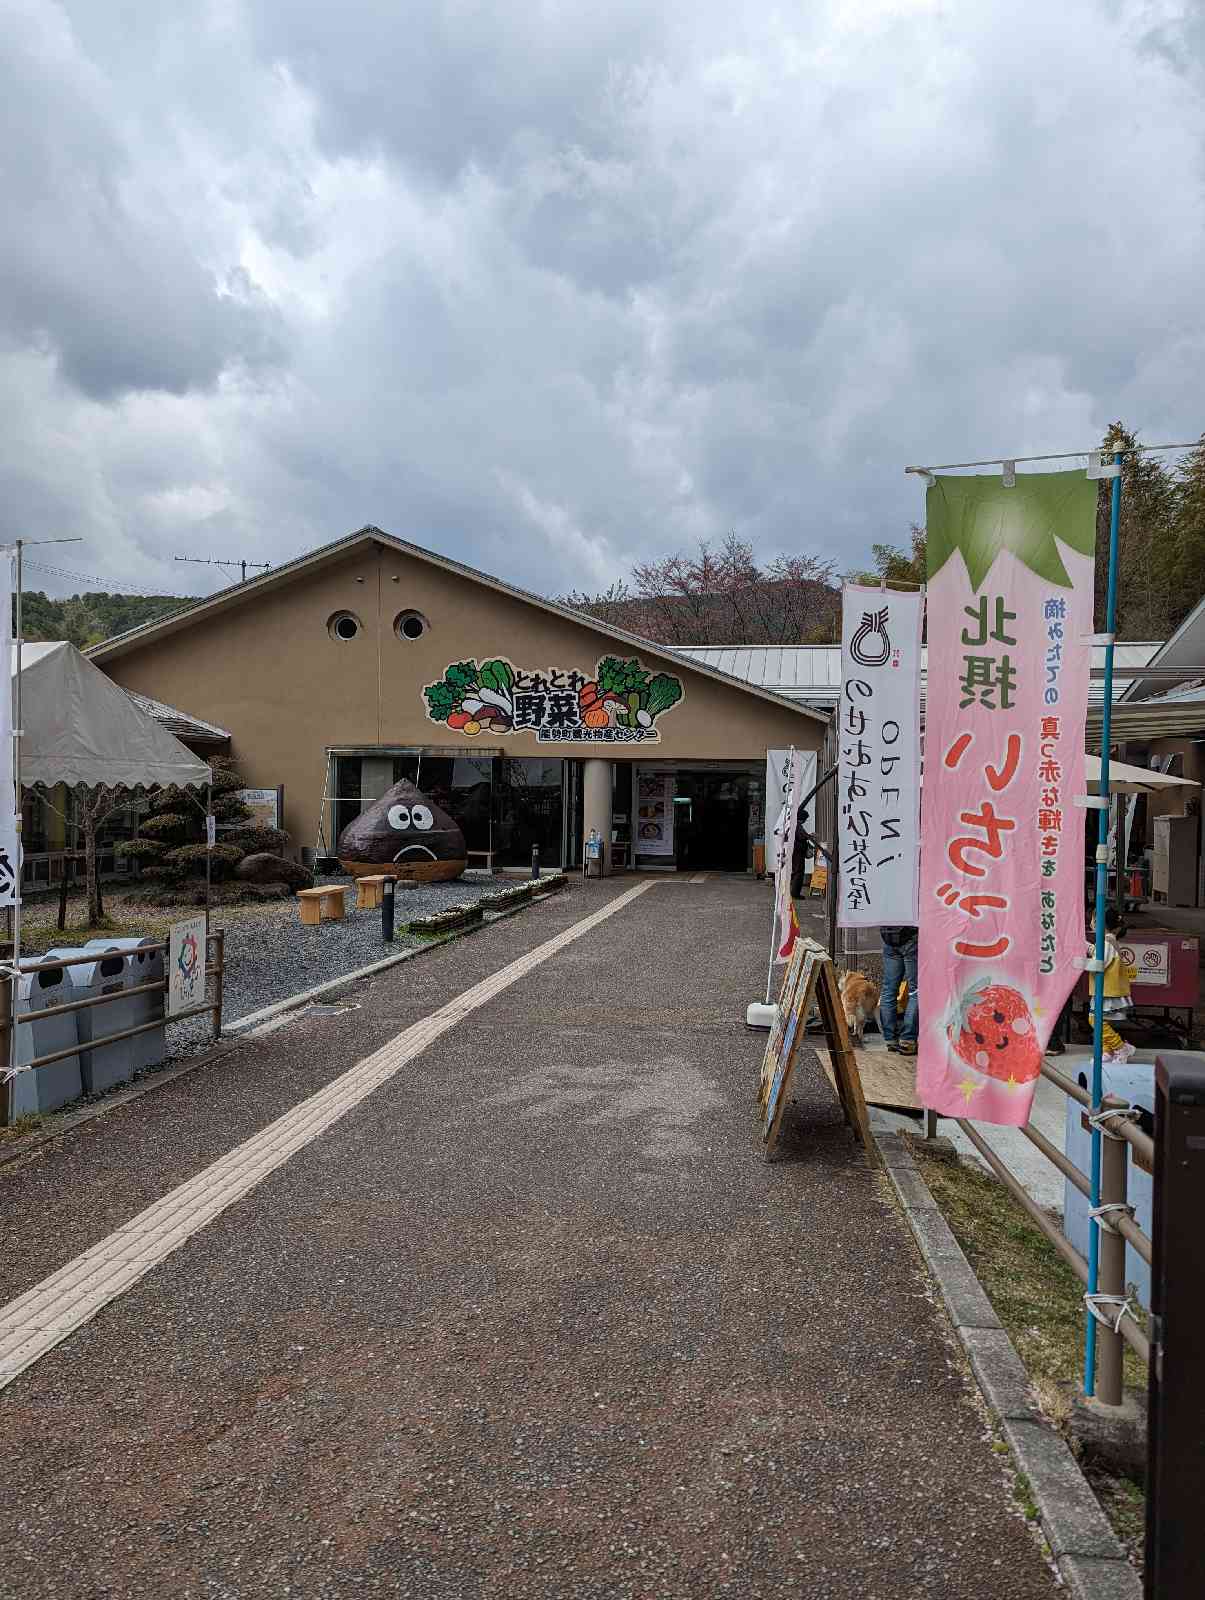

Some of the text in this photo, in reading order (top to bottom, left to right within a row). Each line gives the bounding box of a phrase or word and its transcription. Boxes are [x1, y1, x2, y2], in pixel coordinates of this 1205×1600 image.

[515, 670, 586, 691] とれとれ
[514, 692, 580, 728] 野菜
[540, 727, 657, 742] 能勢町観光物産センター
